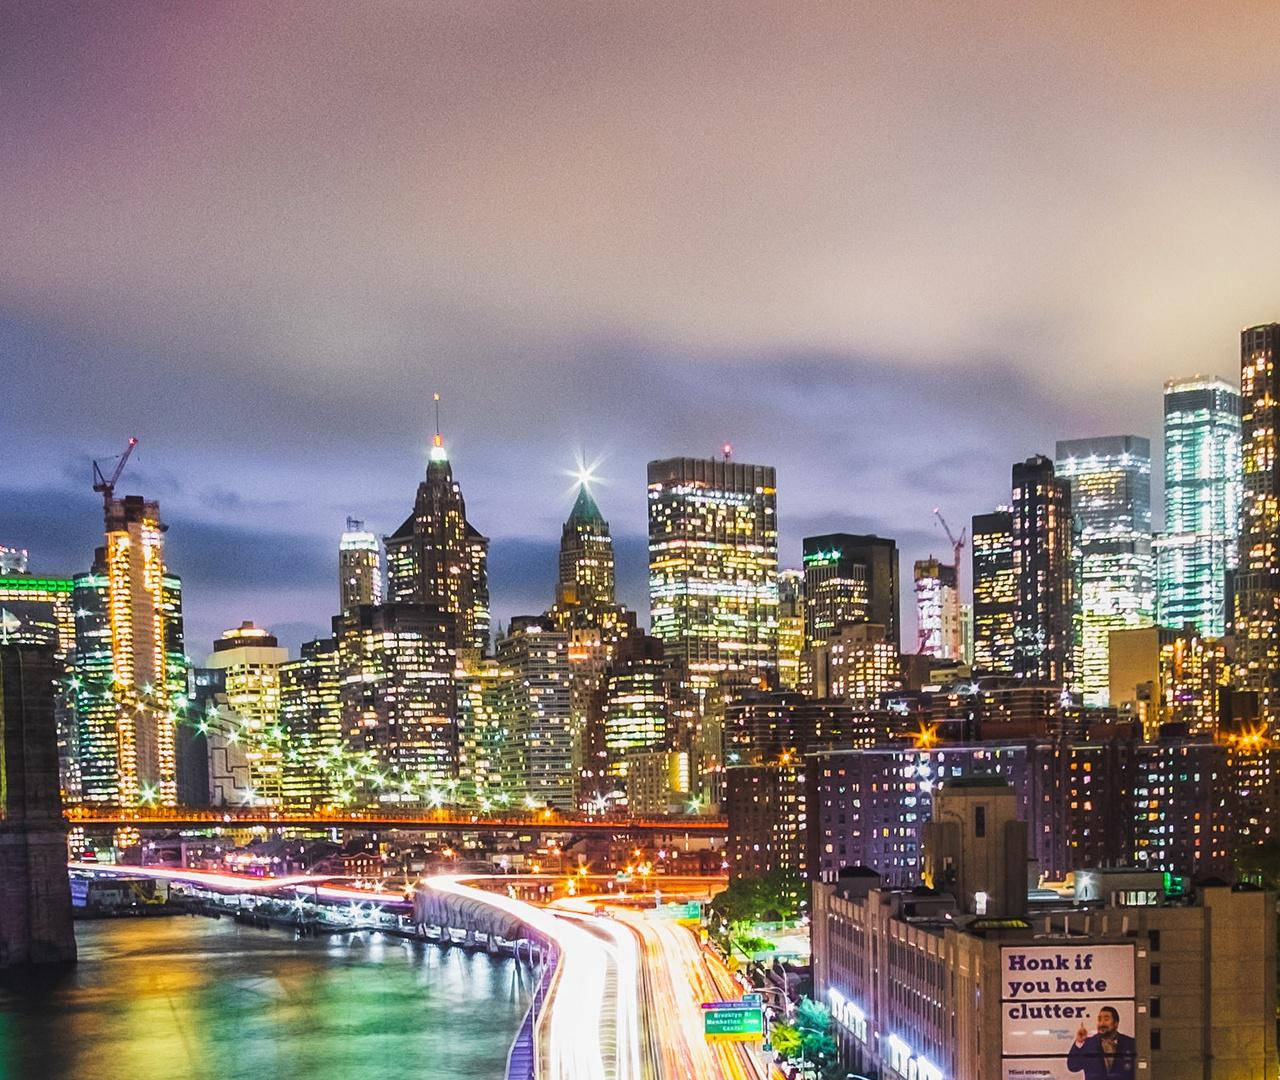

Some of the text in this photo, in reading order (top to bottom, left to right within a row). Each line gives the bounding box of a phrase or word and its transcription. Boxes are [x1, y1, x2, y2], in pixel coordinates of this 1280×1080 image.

[1008, 954, 1093, 970] Honk if
[1008, 977, 1107, 997] you hate
[1008, 1004, 1090, 1019] clutter.
